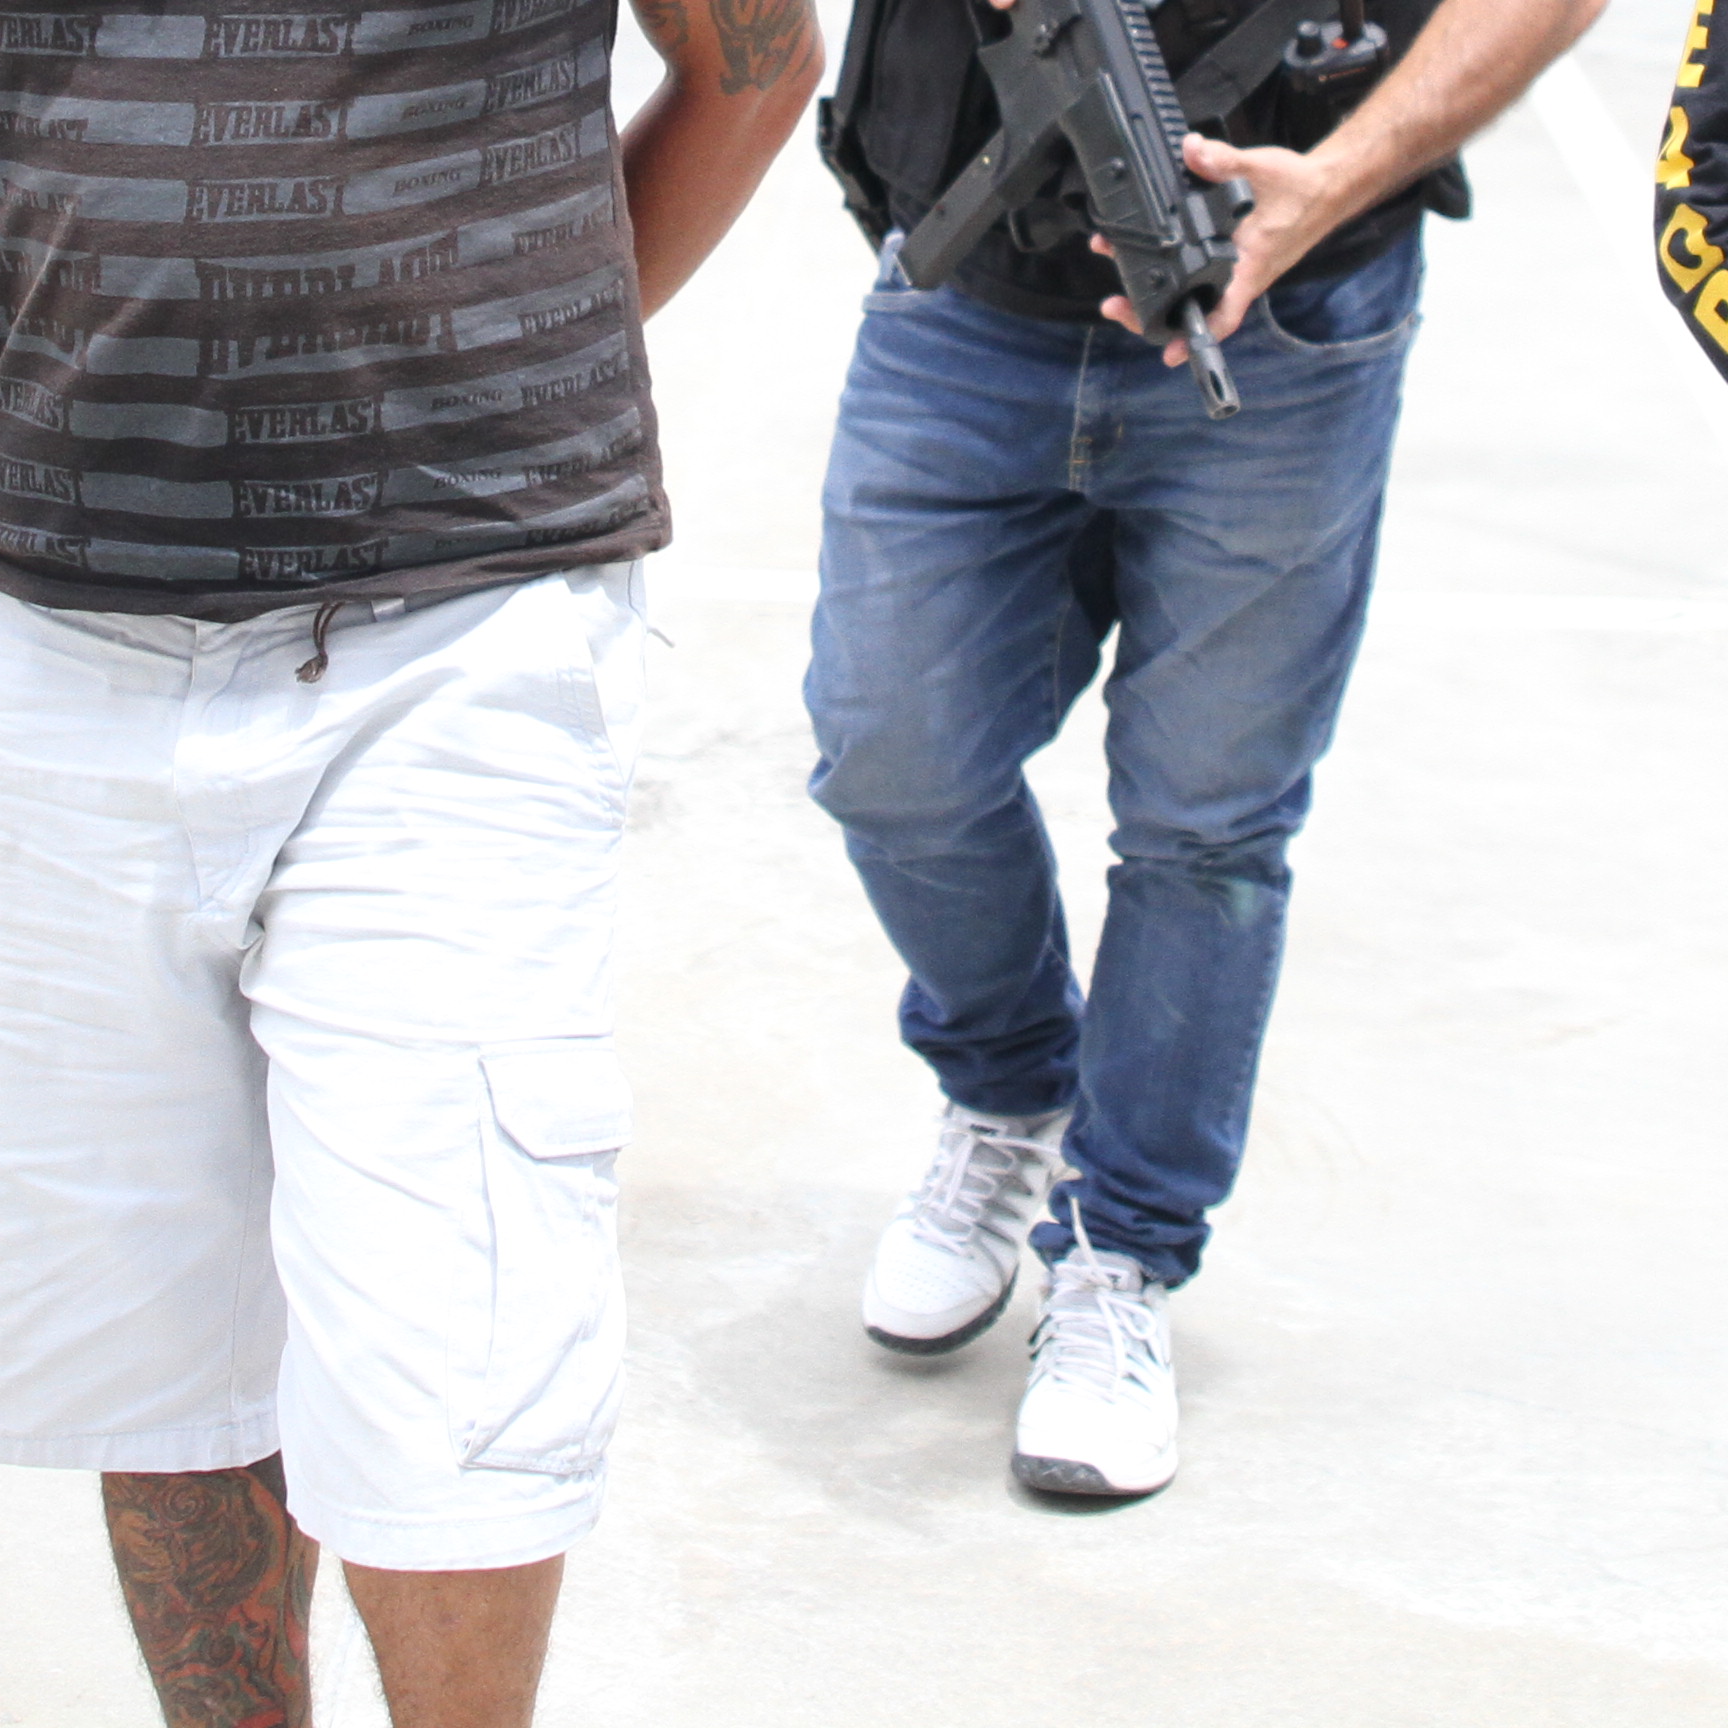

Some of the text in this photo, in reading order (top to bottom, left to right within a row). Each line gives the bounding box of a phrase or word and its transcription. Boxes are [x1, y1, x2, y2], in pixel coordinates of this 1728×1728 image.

[203, 12, 362, 58] EVERLAST
[192, 98, 352, 148] EVERLAST
[185, 173, 347, 223] EVERLAST
[392, 169, 462, 196] BOXING
[225, 402, 384, 447] EVERLAST
[232, 472, 390, 521] EVERLAST
[237, 535, 390, 585] EVERLAST
